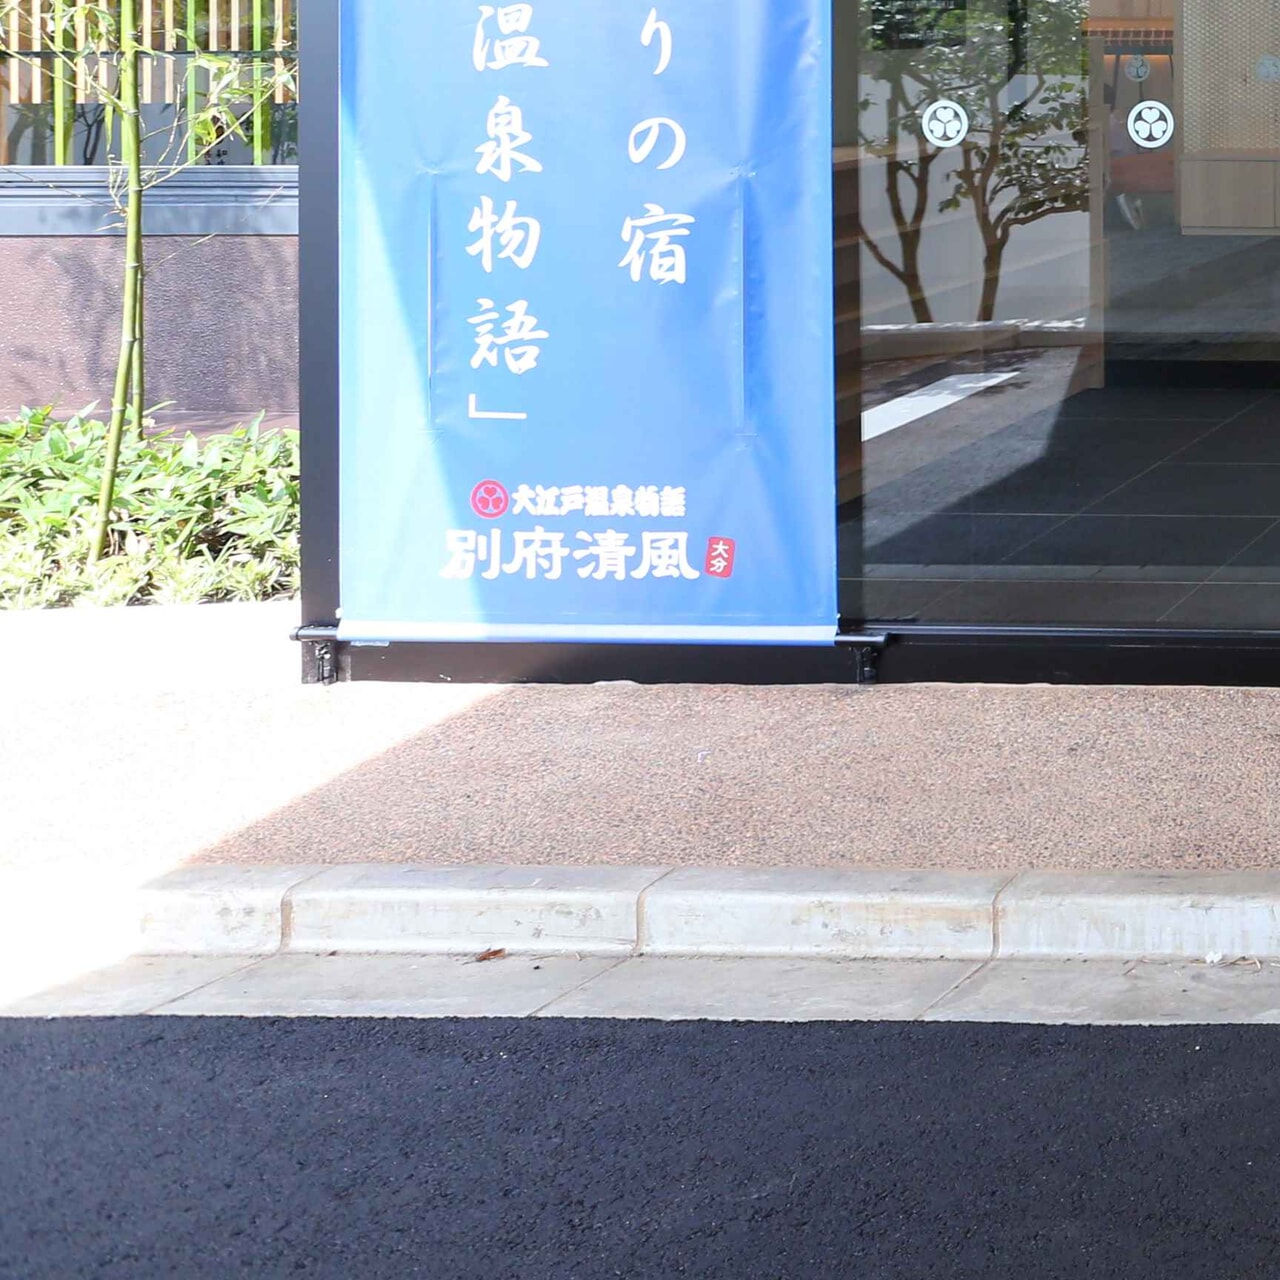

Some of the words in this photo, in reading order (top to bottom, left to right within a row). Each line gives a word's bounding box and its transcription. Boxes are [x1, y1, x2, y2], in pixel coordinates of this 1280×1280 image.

[511, 484, 687, 517] 大江戸温泉物語
[439, 525, 701, 581] 別府清風
[709, 539, 729, 573] 大分
